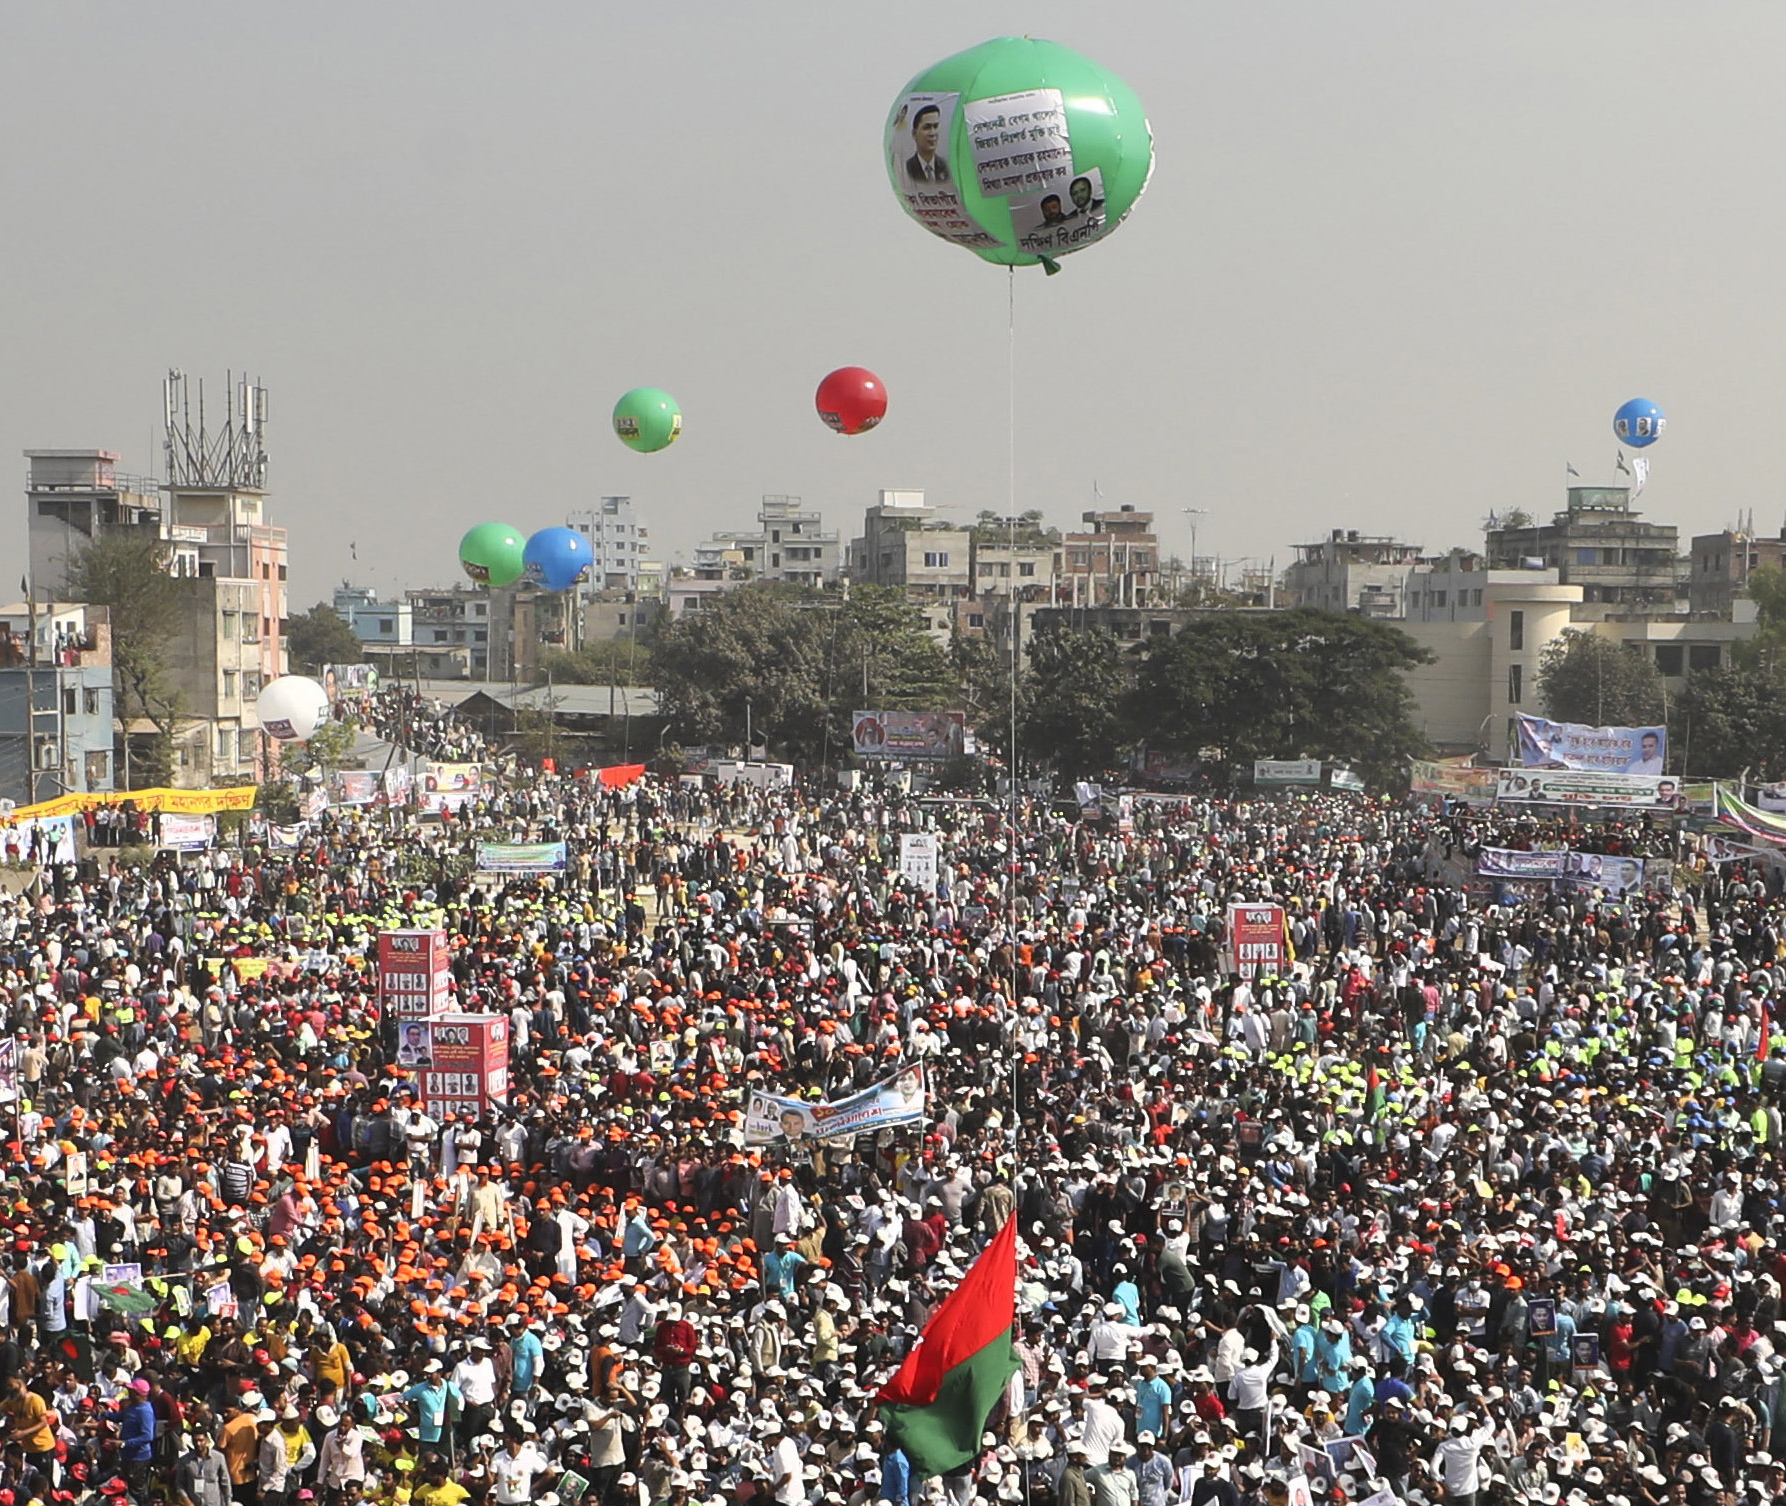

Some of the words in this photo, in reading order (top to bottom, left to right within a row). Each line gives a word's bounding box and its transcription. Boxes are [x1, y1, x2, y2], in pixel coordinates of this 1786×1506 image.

[1008, 113, 1030, 127] বেগম
[1028, 125, 1046, 142] মুক্তি
[1010, 152, 1036, 166] তারেক
[1020, 233, 1052, 250] দক্ষিণ
[1057, 217, 1099, 247] বিএনপি
[170, 795, 212, 808] মহানগর
[215, 791, 251, 810] দক্ষিণ
